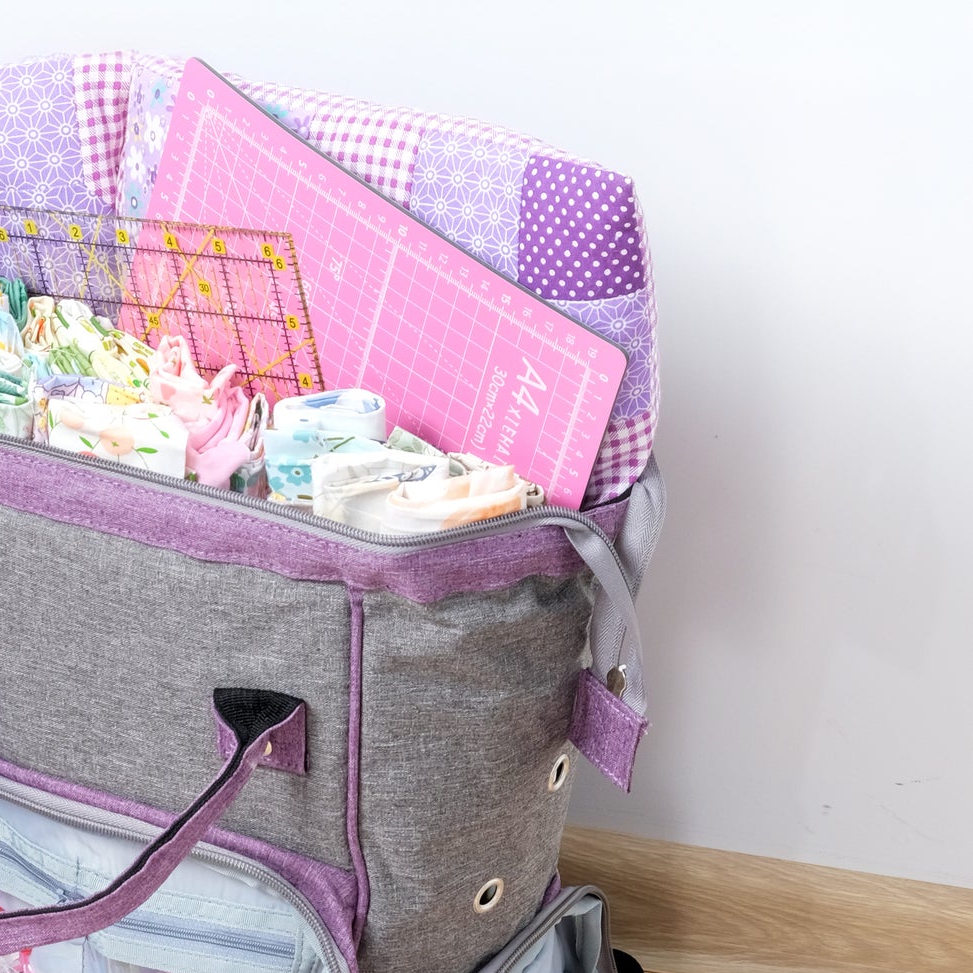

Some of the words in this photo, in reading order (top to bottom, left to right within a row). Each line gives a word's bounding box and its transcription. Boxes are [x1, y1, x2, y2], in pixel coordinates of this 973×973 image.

[298, 160, 307, 169] 5
[358, 201, 367, 210] 8
[397, 224, 409, 237] 10
[418, 241, 428, 251] 11
[438, 253, 449, 265] 12
[459, 266, 470, 279] 13
[480, 280, 490, 291] 14
[501, 293, 512, 306] 15
[522, 307, 533, 318] 16
[544, 320, 555, 332] 17
[566, 333, 576, 345] 18
[587, 347, 598, 359] 19
[329, 257, 344, 282] 75°
[149, 316, 159, 326] 45
[516, 356, 547, 417] A4
